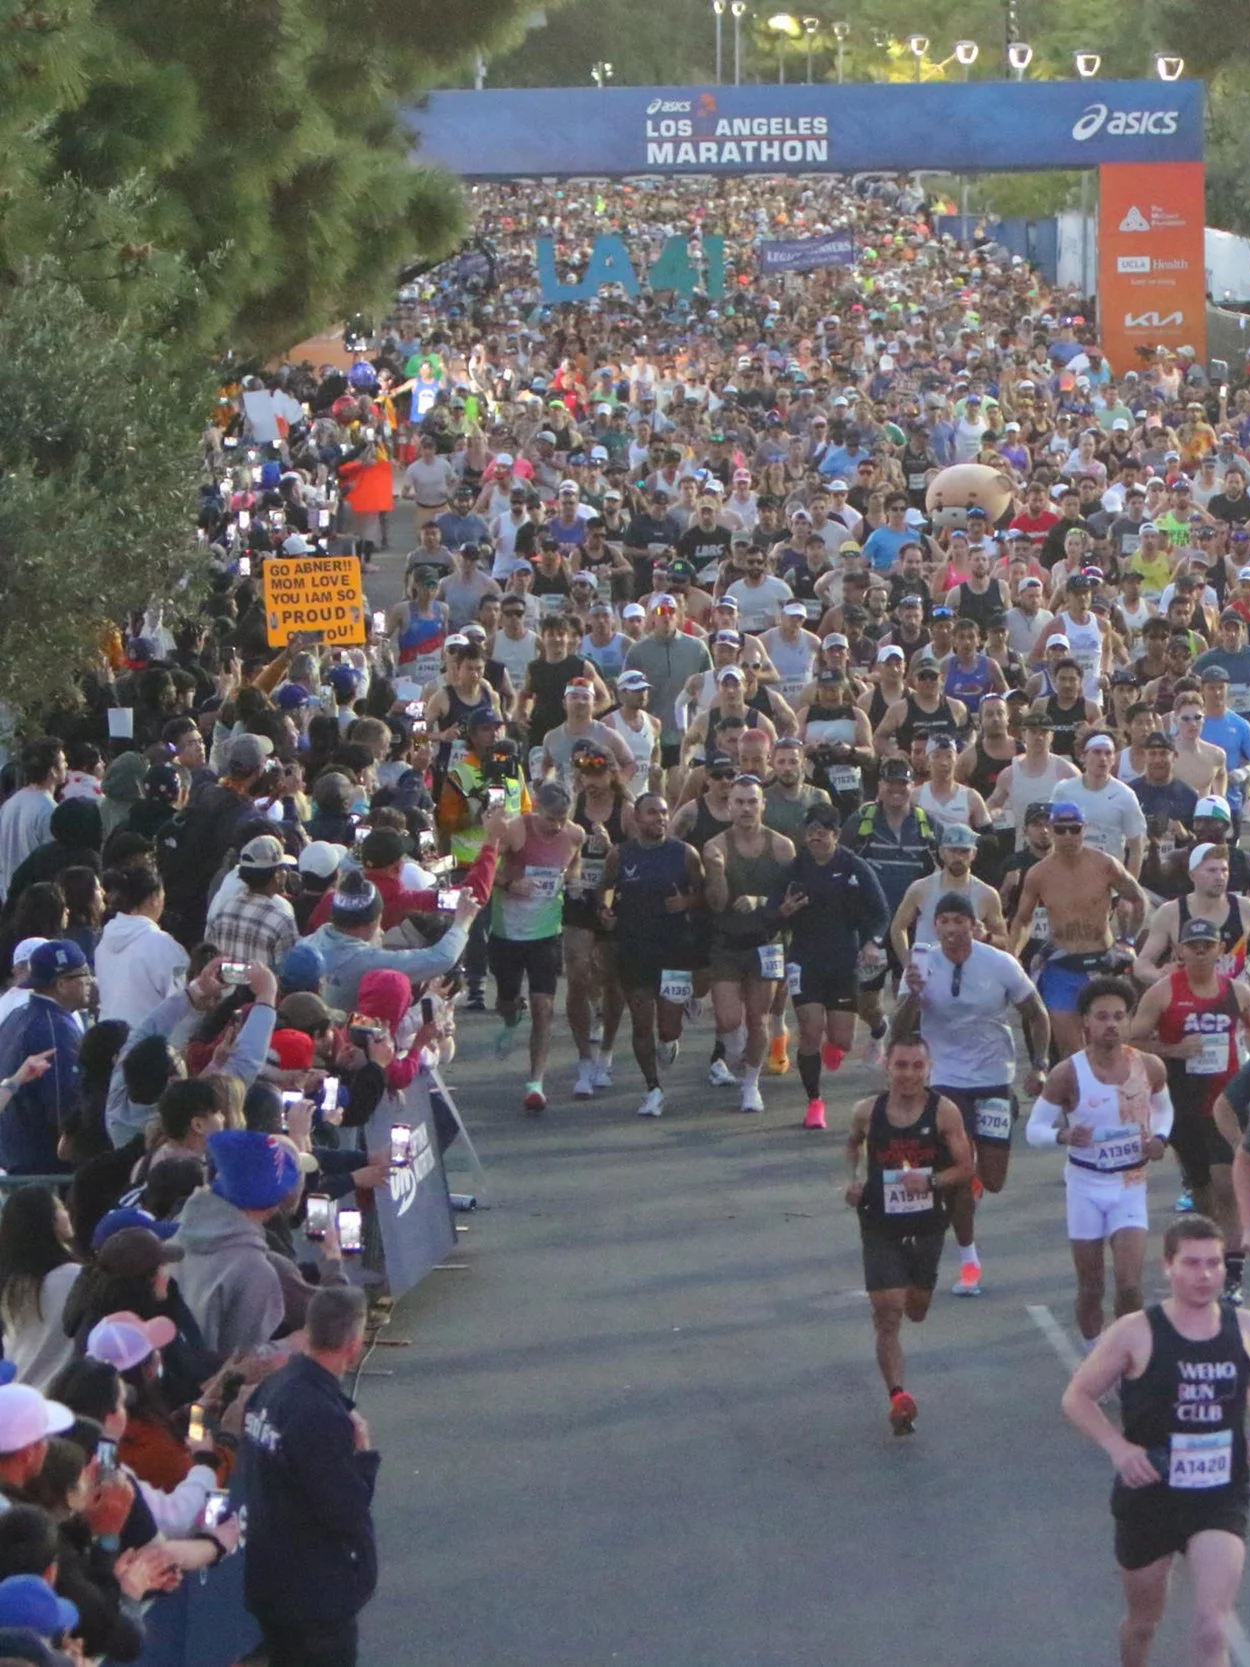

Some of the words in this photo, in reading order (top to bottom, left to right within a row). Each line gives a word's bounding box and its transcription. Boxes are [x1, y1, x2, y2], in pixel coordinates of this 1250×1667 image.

[646, 119, 693, 137] LOS
[715, 117, 828, 137] ANGELES
[1107, 111, 1178, 135] asics
[646, 139, 828, 164] MARATHON
[1152, 259, 1189, 270] Health
[269, 564, 290, 577] GO
[294, 559, 352, 575] ABNER!!
[271, 578, 305, 590] MOM
[311, 574, 350, 588] LOVE
[271, 593, 300, 605] YOU
[304, 593, 309, 604] I
[311, 591, 333, 603] AM
[337, 589, 357, 602] SO
[281, 606, 346, 624] PROUD
[1184, 1012, 1231, 1033] ACP
[1178, 1360, 1237, 1380] WEHO
[1178, 1383, 1215, 1401] RUN
[1176, 1404, 1223, 1422] CLUB
[1173, 1456, 1227, 1477] A1420
